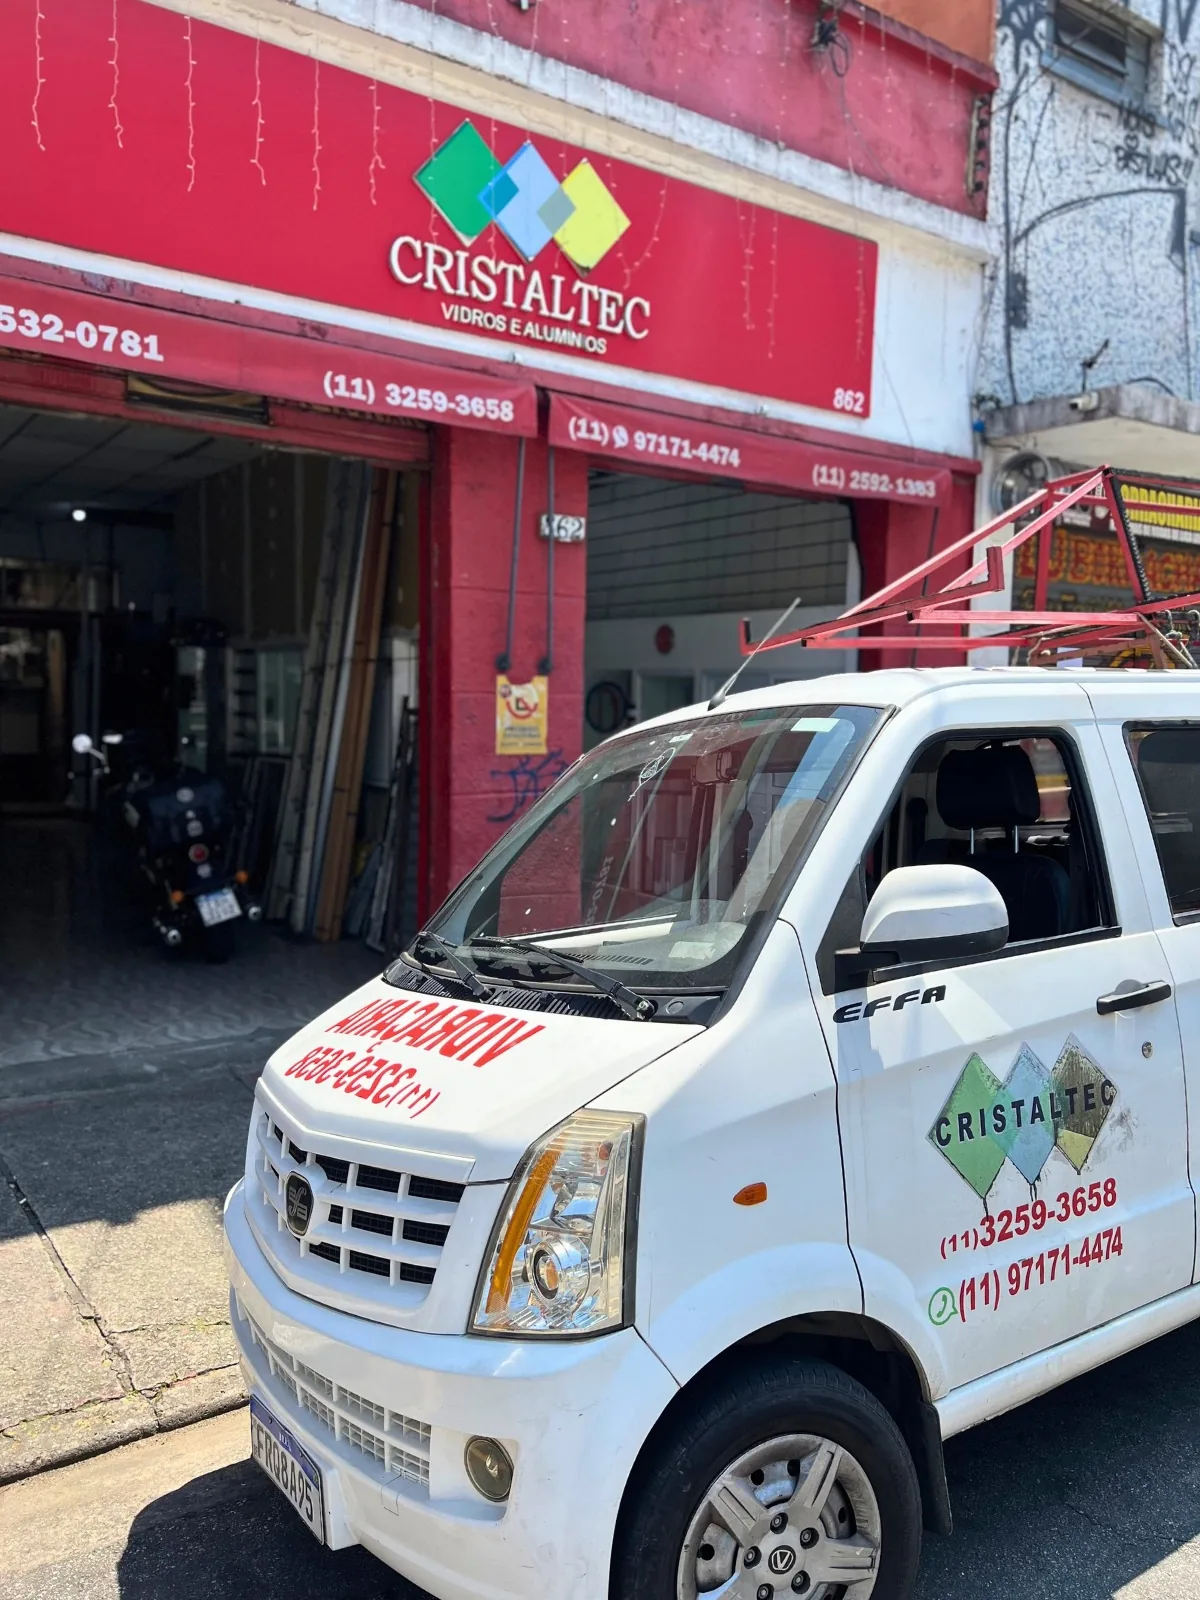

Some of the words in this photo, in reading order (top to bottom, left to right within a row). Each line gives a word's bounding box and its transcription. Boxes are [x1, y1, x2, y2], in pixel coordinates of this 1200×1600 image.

[390, 236, 650, 339] CRISTALTEC
[441, 302, 507, 333] VIDROS
[510, 317, 521, 335] E
[323, 371, 376, 405] (11)
[385, 383, 515, 422] 3259-3658
[833, 387, 865, 413] 862
[568, 416, 610, 447] (11)
[633, 430, 741, 468] 97171-4474
[812, 464, 846, 491] (11)
[832, 984, 947, 1024] EFFA
[935, 1079, 1118, 1147] CRISTALTEC
[958, 1270, 1001, 1323] (11)
[1007, 1226, 1123, 1297] 97171-4474
[256, 1425, 313, 1522] FRQ8A95
